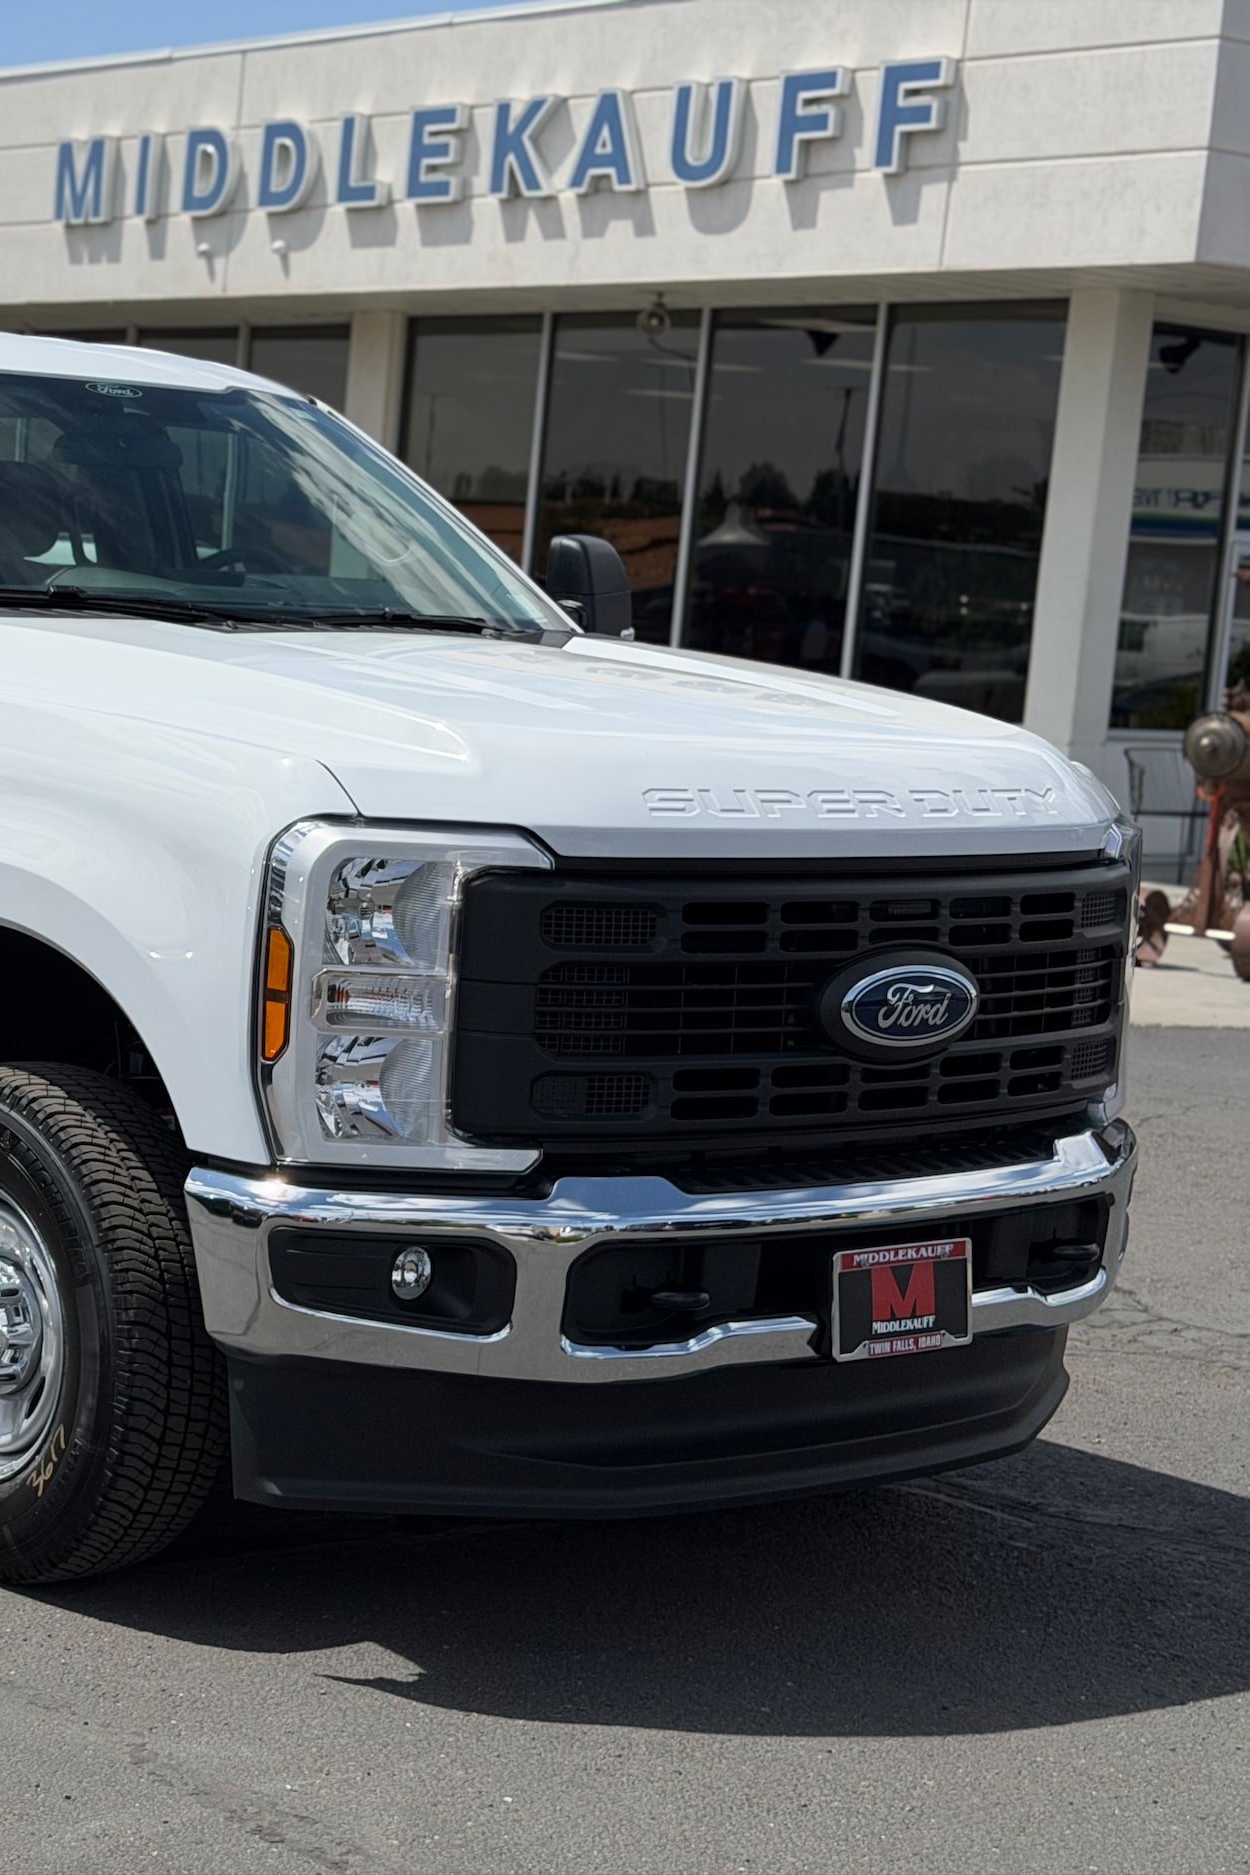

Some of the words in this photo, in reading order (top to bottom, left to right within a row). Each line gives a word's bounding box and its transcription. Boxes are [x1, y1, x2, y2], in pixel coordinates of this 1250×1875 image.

[54, 56, 956, 227] MIDDLEKAUFF
[96, 384, 134, 396] Ford
[642, 787, 906, 818] SUPER
[908, 788, 1058, 817] DUTY
[877, 982, 952, 1029] Ford
[853, 1243, 954, 1267] MIDDLEKAUFF
[871, 1261, 936, 1321] M
[872, 1315, 936, 1335] MIDDLEKAUFF
[869, 1342, 891, 1355] TWIN
[892, 1338, 916, 1353] FALLS,
[918, 1334, 941, 1348] IDAHO
